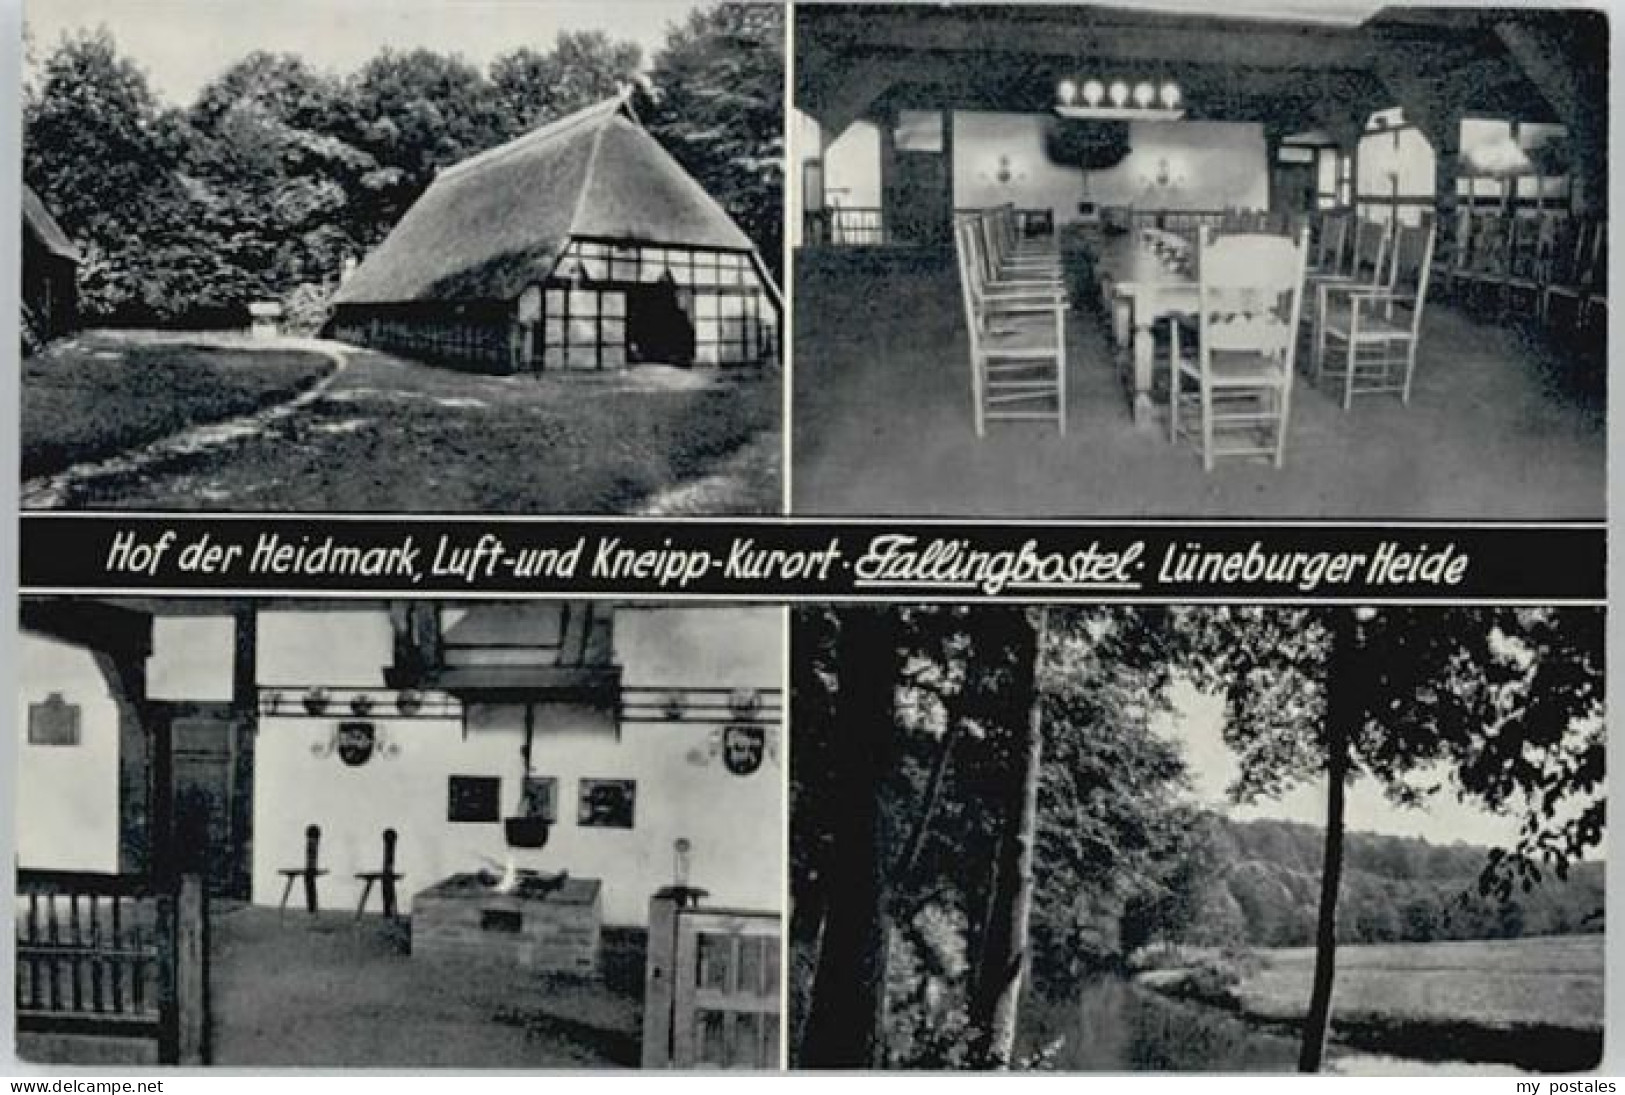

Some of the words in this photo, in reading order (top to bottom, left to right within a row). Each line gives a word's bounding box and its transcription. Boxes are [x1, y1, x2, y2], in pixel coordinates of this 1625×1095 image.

[106, 530, 177, 576] Hof
[178, 533, 242, 574] der
[249, 533, 424, 583] Heidmark,
[1158, 541, 1366, 590] Lüneburger
[1365, 541, 1468, 585] Heide
